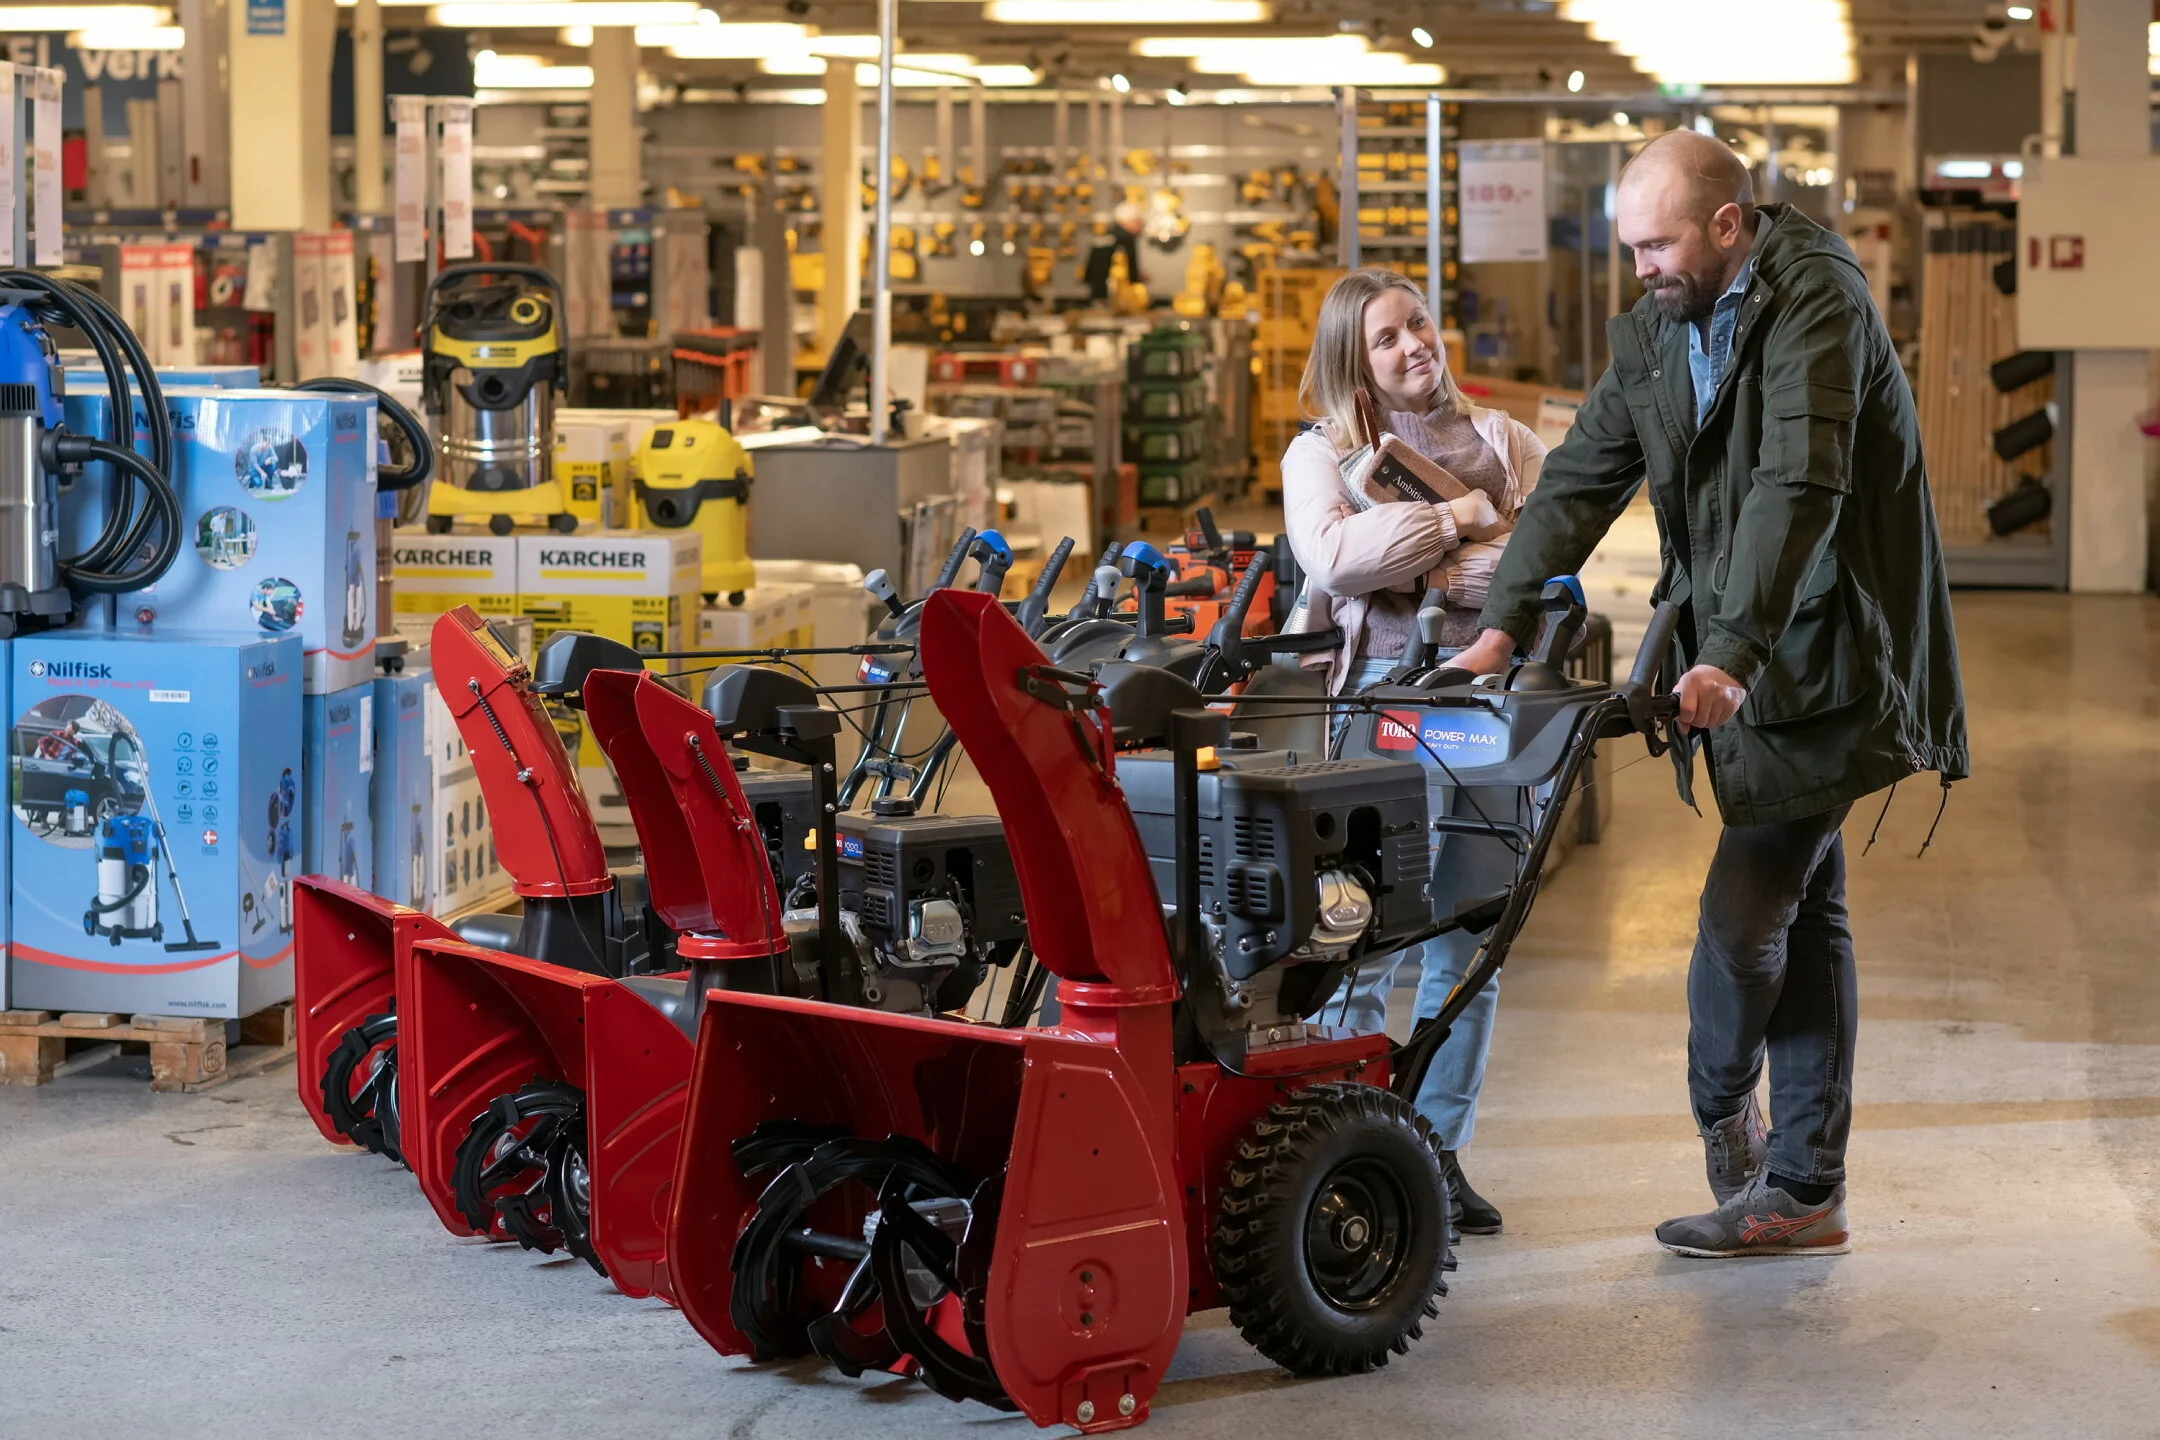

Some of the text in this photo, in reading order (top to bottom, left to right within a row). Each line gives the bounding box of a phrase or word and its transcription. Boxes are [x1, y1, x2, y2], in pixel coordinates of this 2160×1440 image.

[1393, 475, 1430, 504] Ambition
[540, 549, 646, 568] KÄRCHER
[48, 662, 112, 678] Nilfisk
[1425, 729, 1498, 745] POWER MAX
[168, 1000, 227, 1009] www.nilfisk.com
